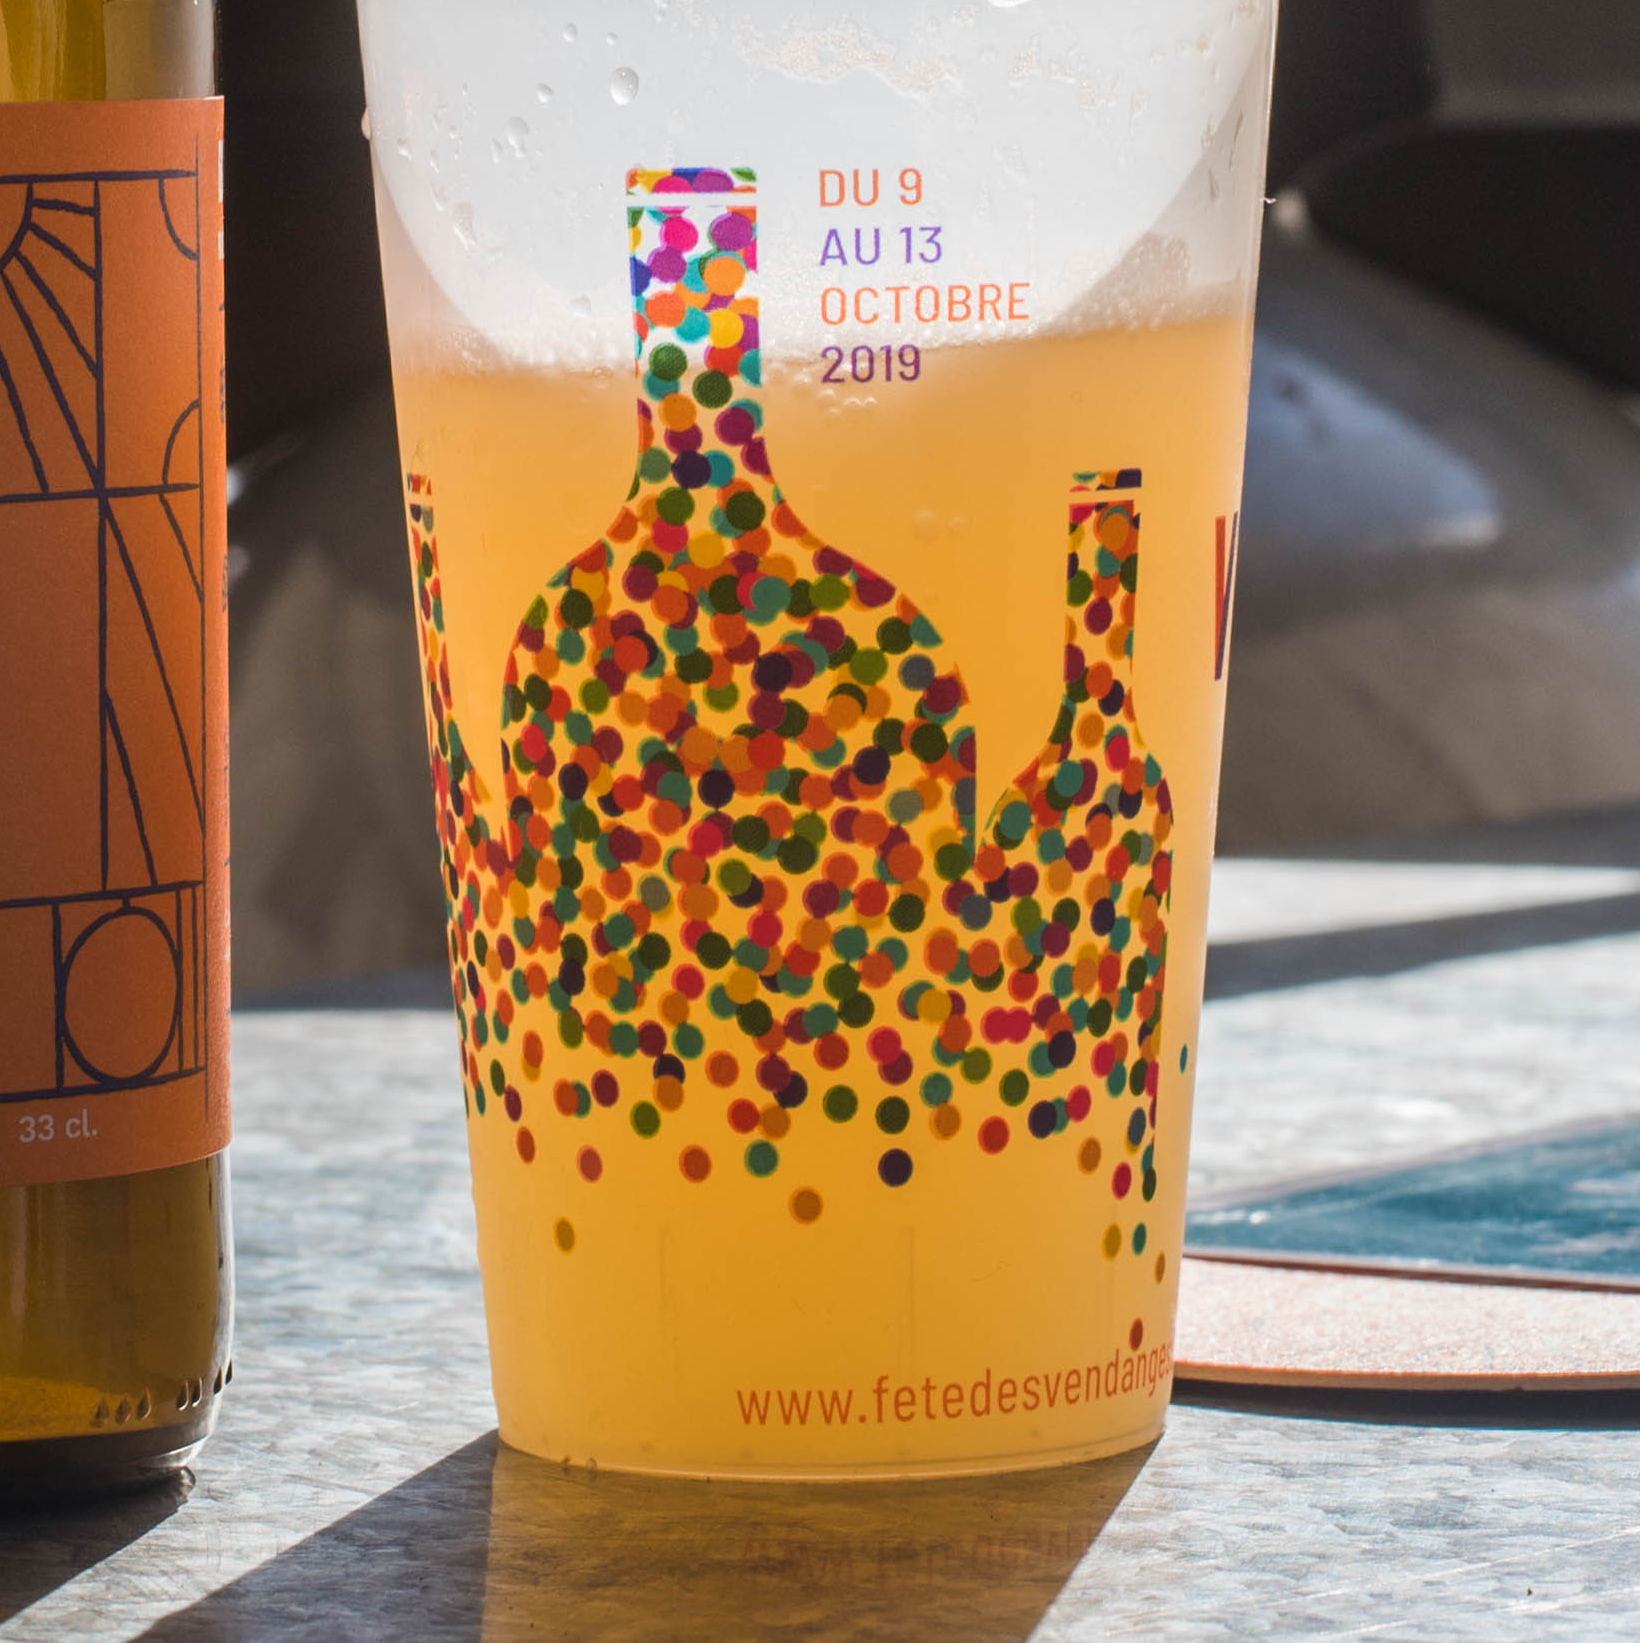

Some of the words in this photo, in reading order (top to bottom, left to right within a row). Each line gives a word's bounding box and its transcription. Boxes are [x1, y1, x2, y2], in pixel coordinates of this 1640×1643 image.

[819, 168, 880, 208] DU
[898, 167, 923, 206] 9
[819, 227, 882, 267] AU
[899, 226, 943, 264] 13
[820, 282, 1031, 326] OCTOBRE
[820, 343, 922, 384] 2019
[18, 1113, 56, 1144] 33
[65, 1108, 98, 1139] cl.
